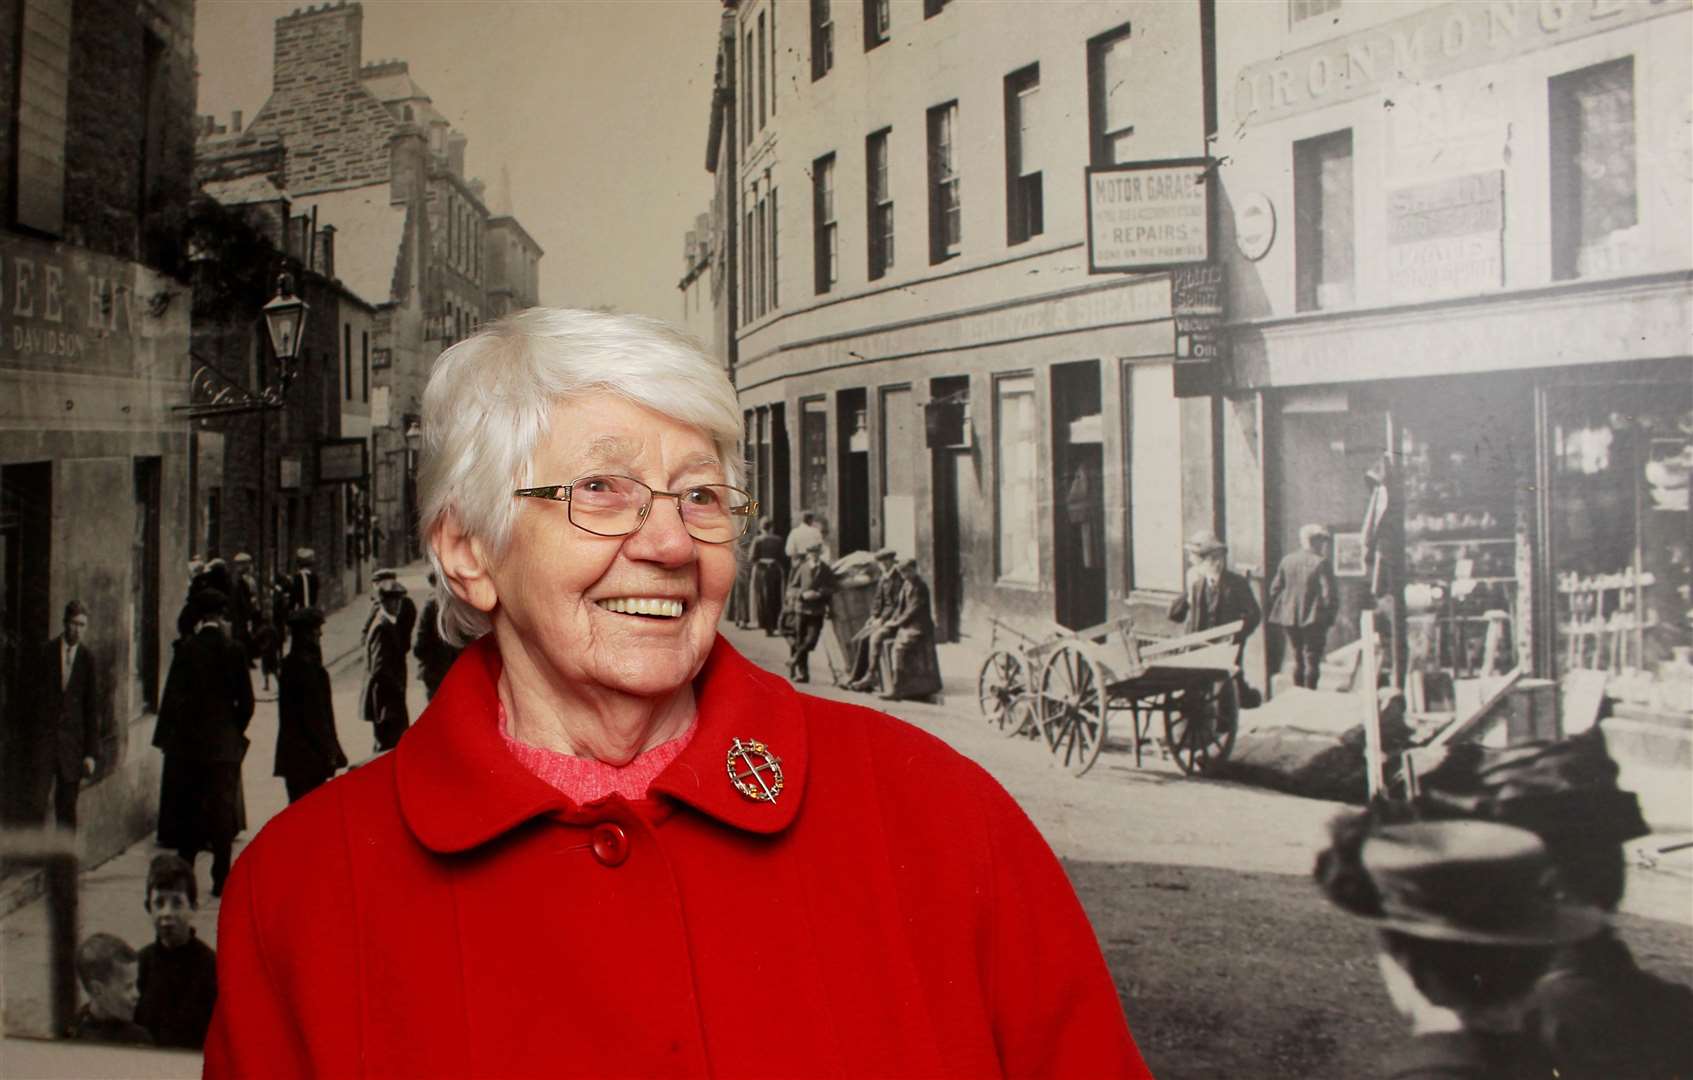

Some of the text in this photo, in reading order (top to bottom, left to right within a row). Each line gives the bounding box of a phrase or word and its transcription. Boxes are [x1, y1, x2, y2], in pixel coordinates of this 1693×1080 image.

[1248, 0, 1670, 113] IRONMONG
[1095, 176, 1142, 204] MOTOR
[1112, 225, 1188, 244] REPAIRS
[0, 256, 63, 323] EE
[12, 325, 84, 358] DAVIDSON
